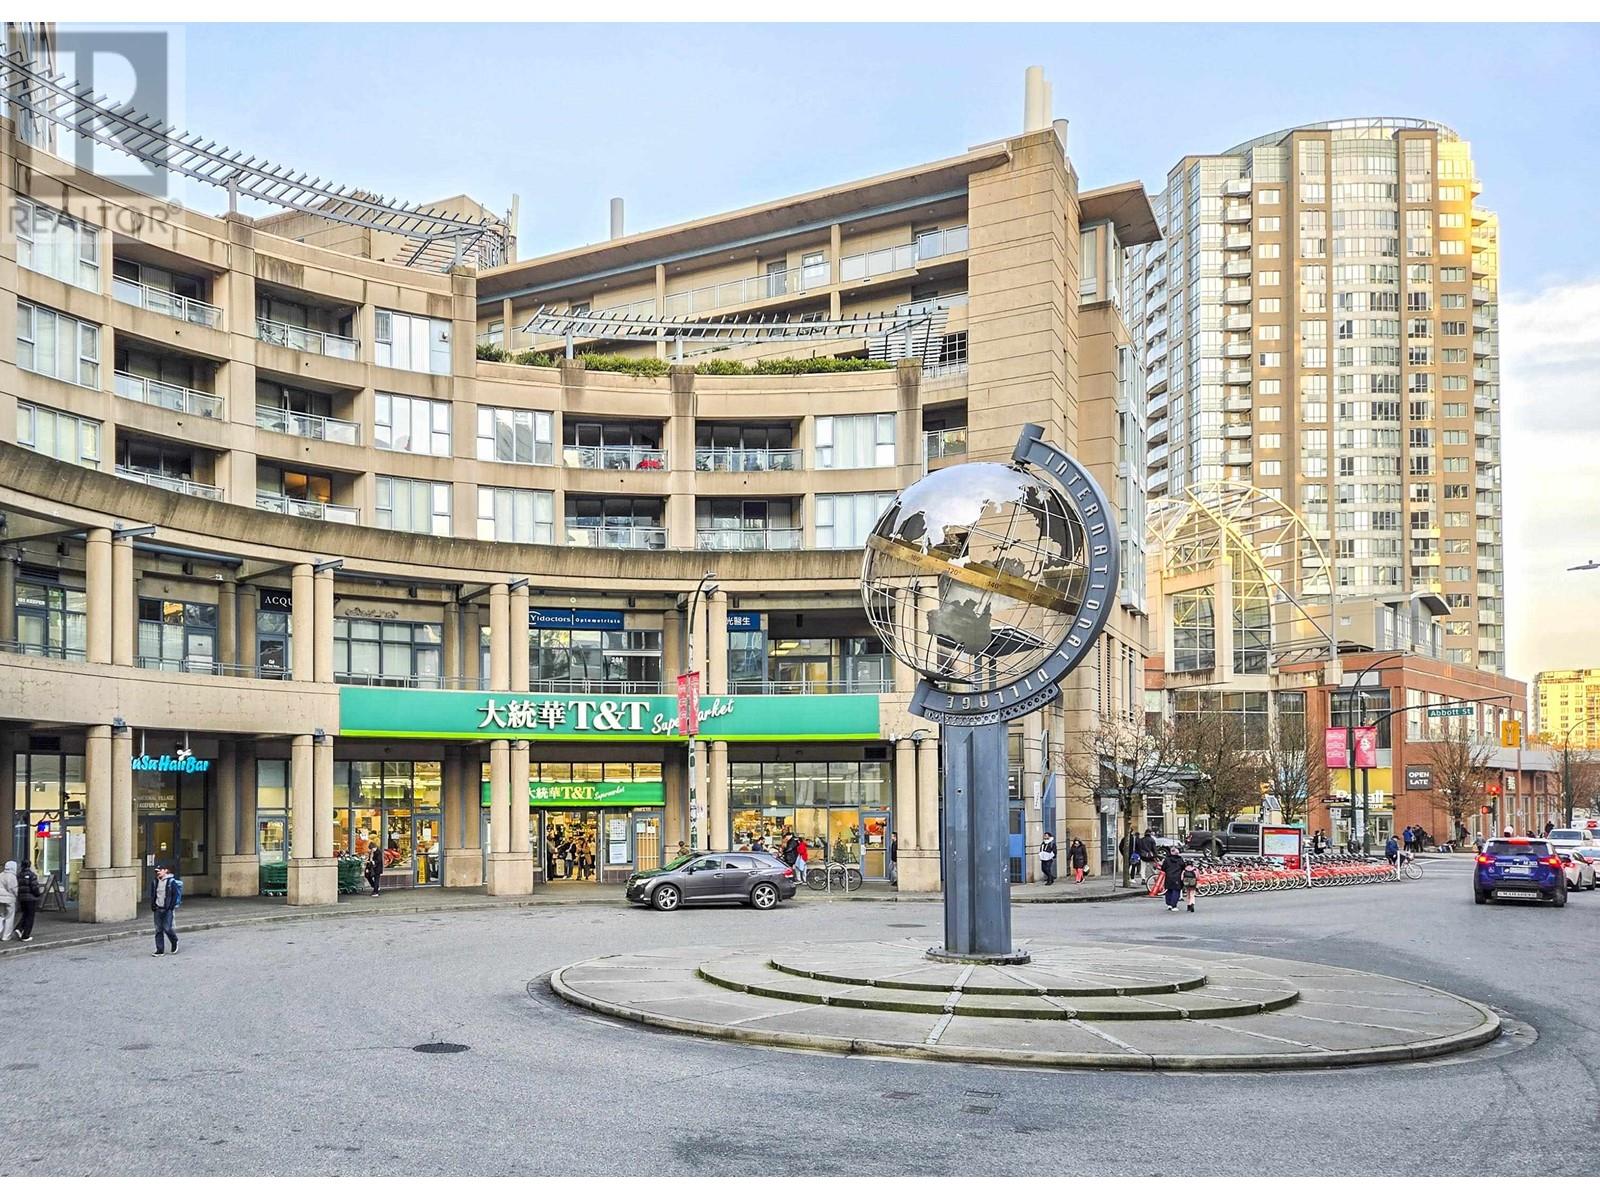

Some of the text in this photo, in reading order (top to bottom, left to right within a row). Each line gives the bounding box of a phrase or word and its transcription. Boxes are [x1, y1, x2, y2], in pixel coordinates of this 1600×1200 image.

[945, 452, 1108, 710] INTERNATIONAL VILLAGE
[264, 596, 292, 607] ACQU
[530, 614, 571, 622] Yidoctors
[478, 699, 567, 729] 大統華
[568, 700, 650, 731] T&T
[651, 698, 736, 737] Supearket
[1430, 709, 1460, 717] Abbott
[560, 786, 596, 800] T&T
